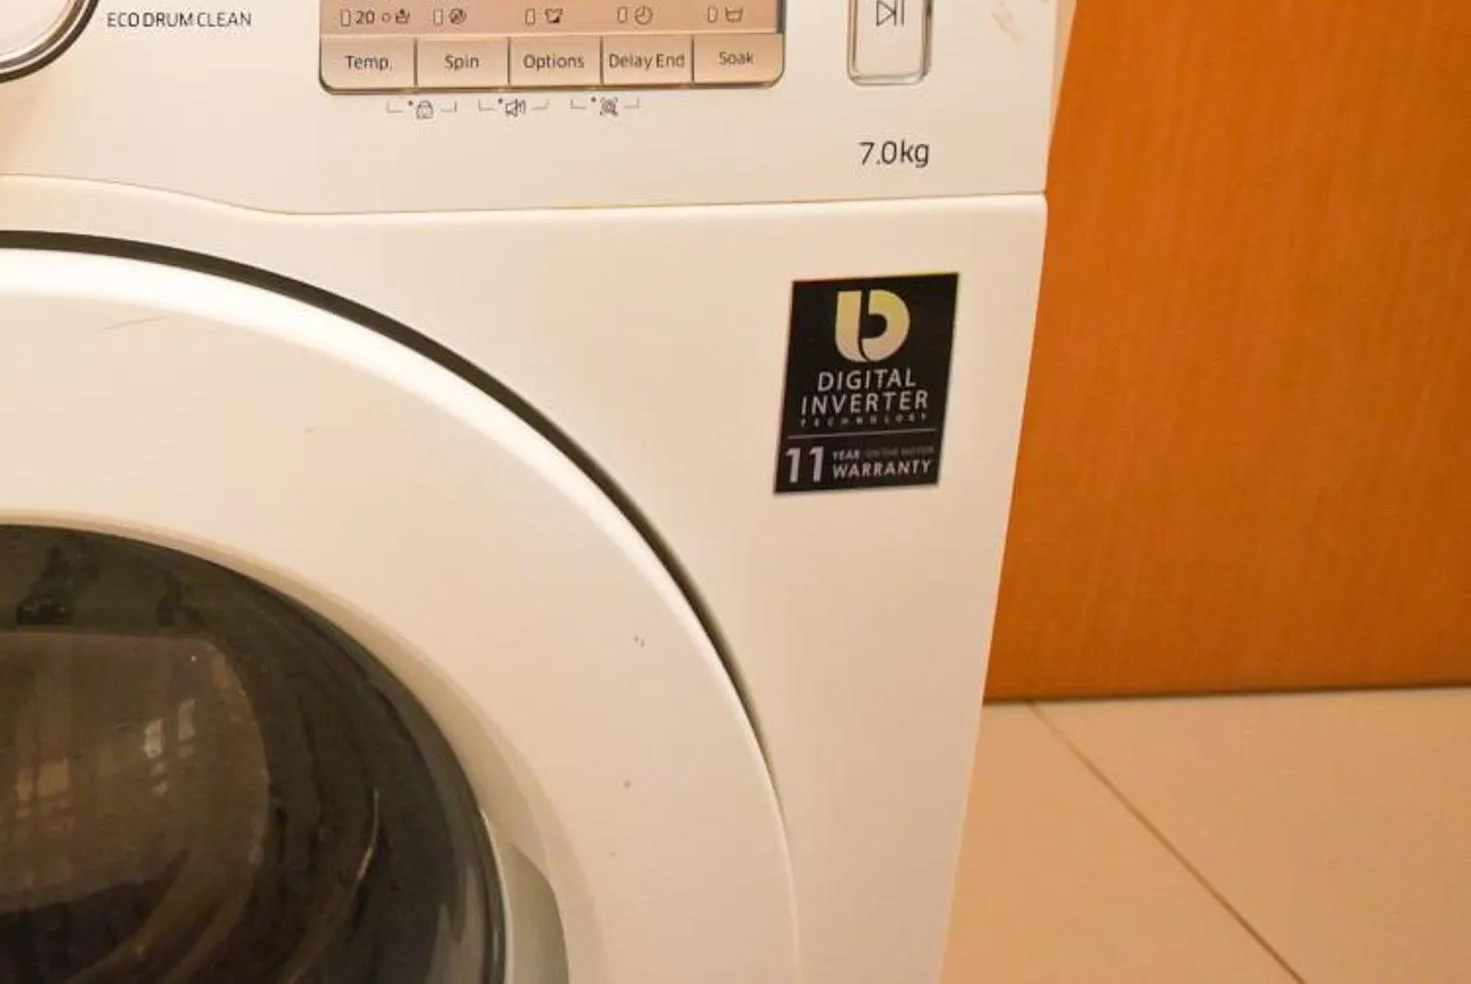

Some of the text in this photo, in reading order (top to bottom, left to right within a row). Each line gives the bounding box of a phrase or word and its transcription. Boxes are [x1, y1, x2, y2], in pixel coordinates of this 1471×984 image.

[356, 10, 375, 24] 20
[345, 55, 392, 71] Temp.
[445, 54, 479, 71] Spin
[523, 54, 584, 71] Options
[609, 53, 684, 69] Delay End
[719, 52, 753, 65] Soak
[817, 368, 916, 392] DIGITAL
[801, 390, 928, 415] INVERTER
[832, 449, 861, 461] YEAR
[785, 446, 824, 483] 11
[832, 459, 931, 478] WARRANTY
